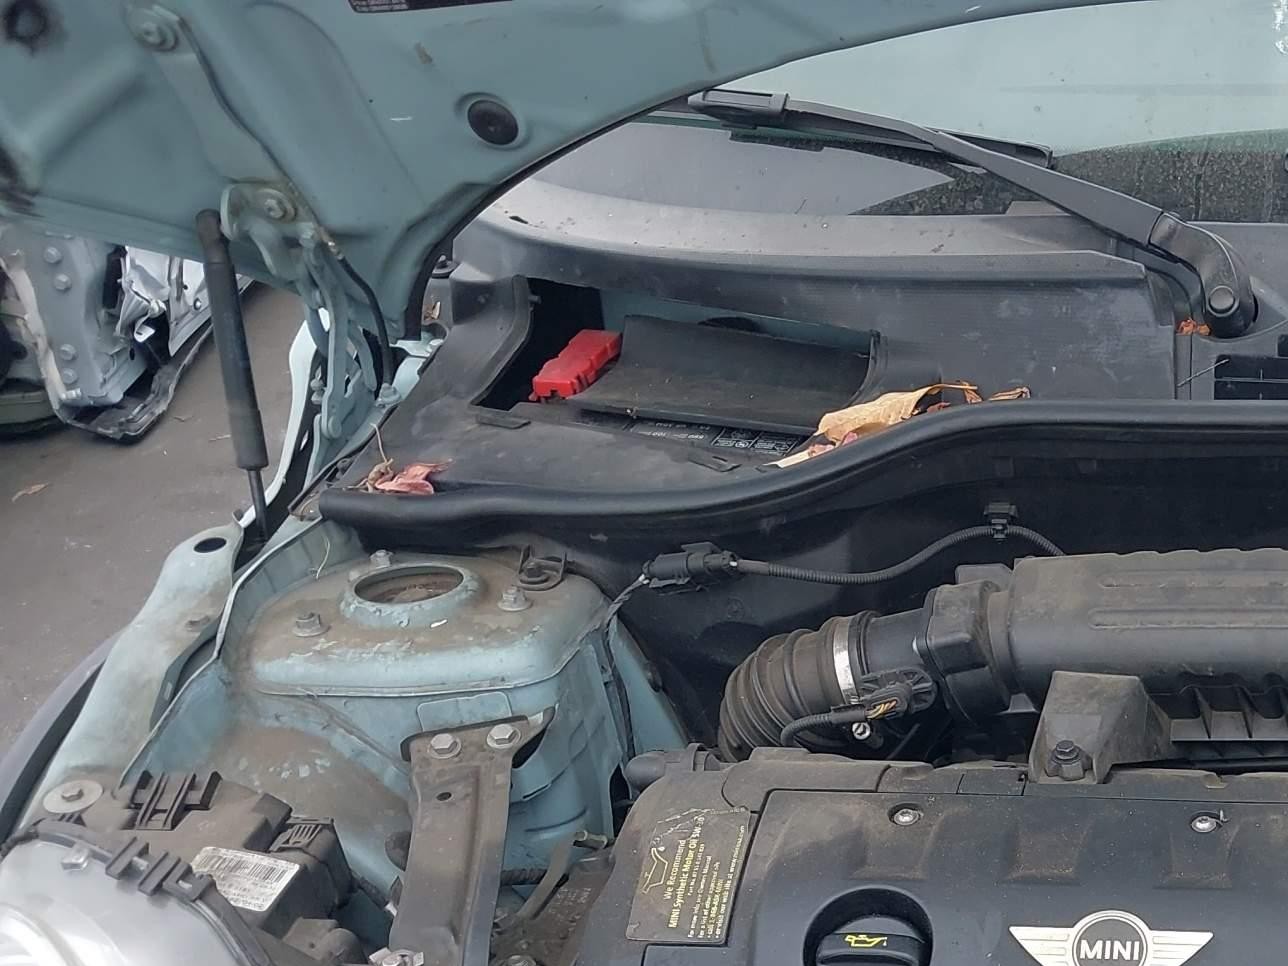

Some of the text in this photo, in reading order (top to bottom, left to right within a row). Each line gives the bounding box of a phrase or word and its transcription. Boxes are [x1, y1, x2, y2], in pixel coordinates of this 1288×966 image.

[688, 838, 698, 849] Oil
[663, 839, 686, 899] We Recommend
[681, 849, 694, 871] Motor
[673, 873, 688, 907] Synthetic
[668, 908, 680, 927] MINI
[1080, 940, 1140, 960] MINI
